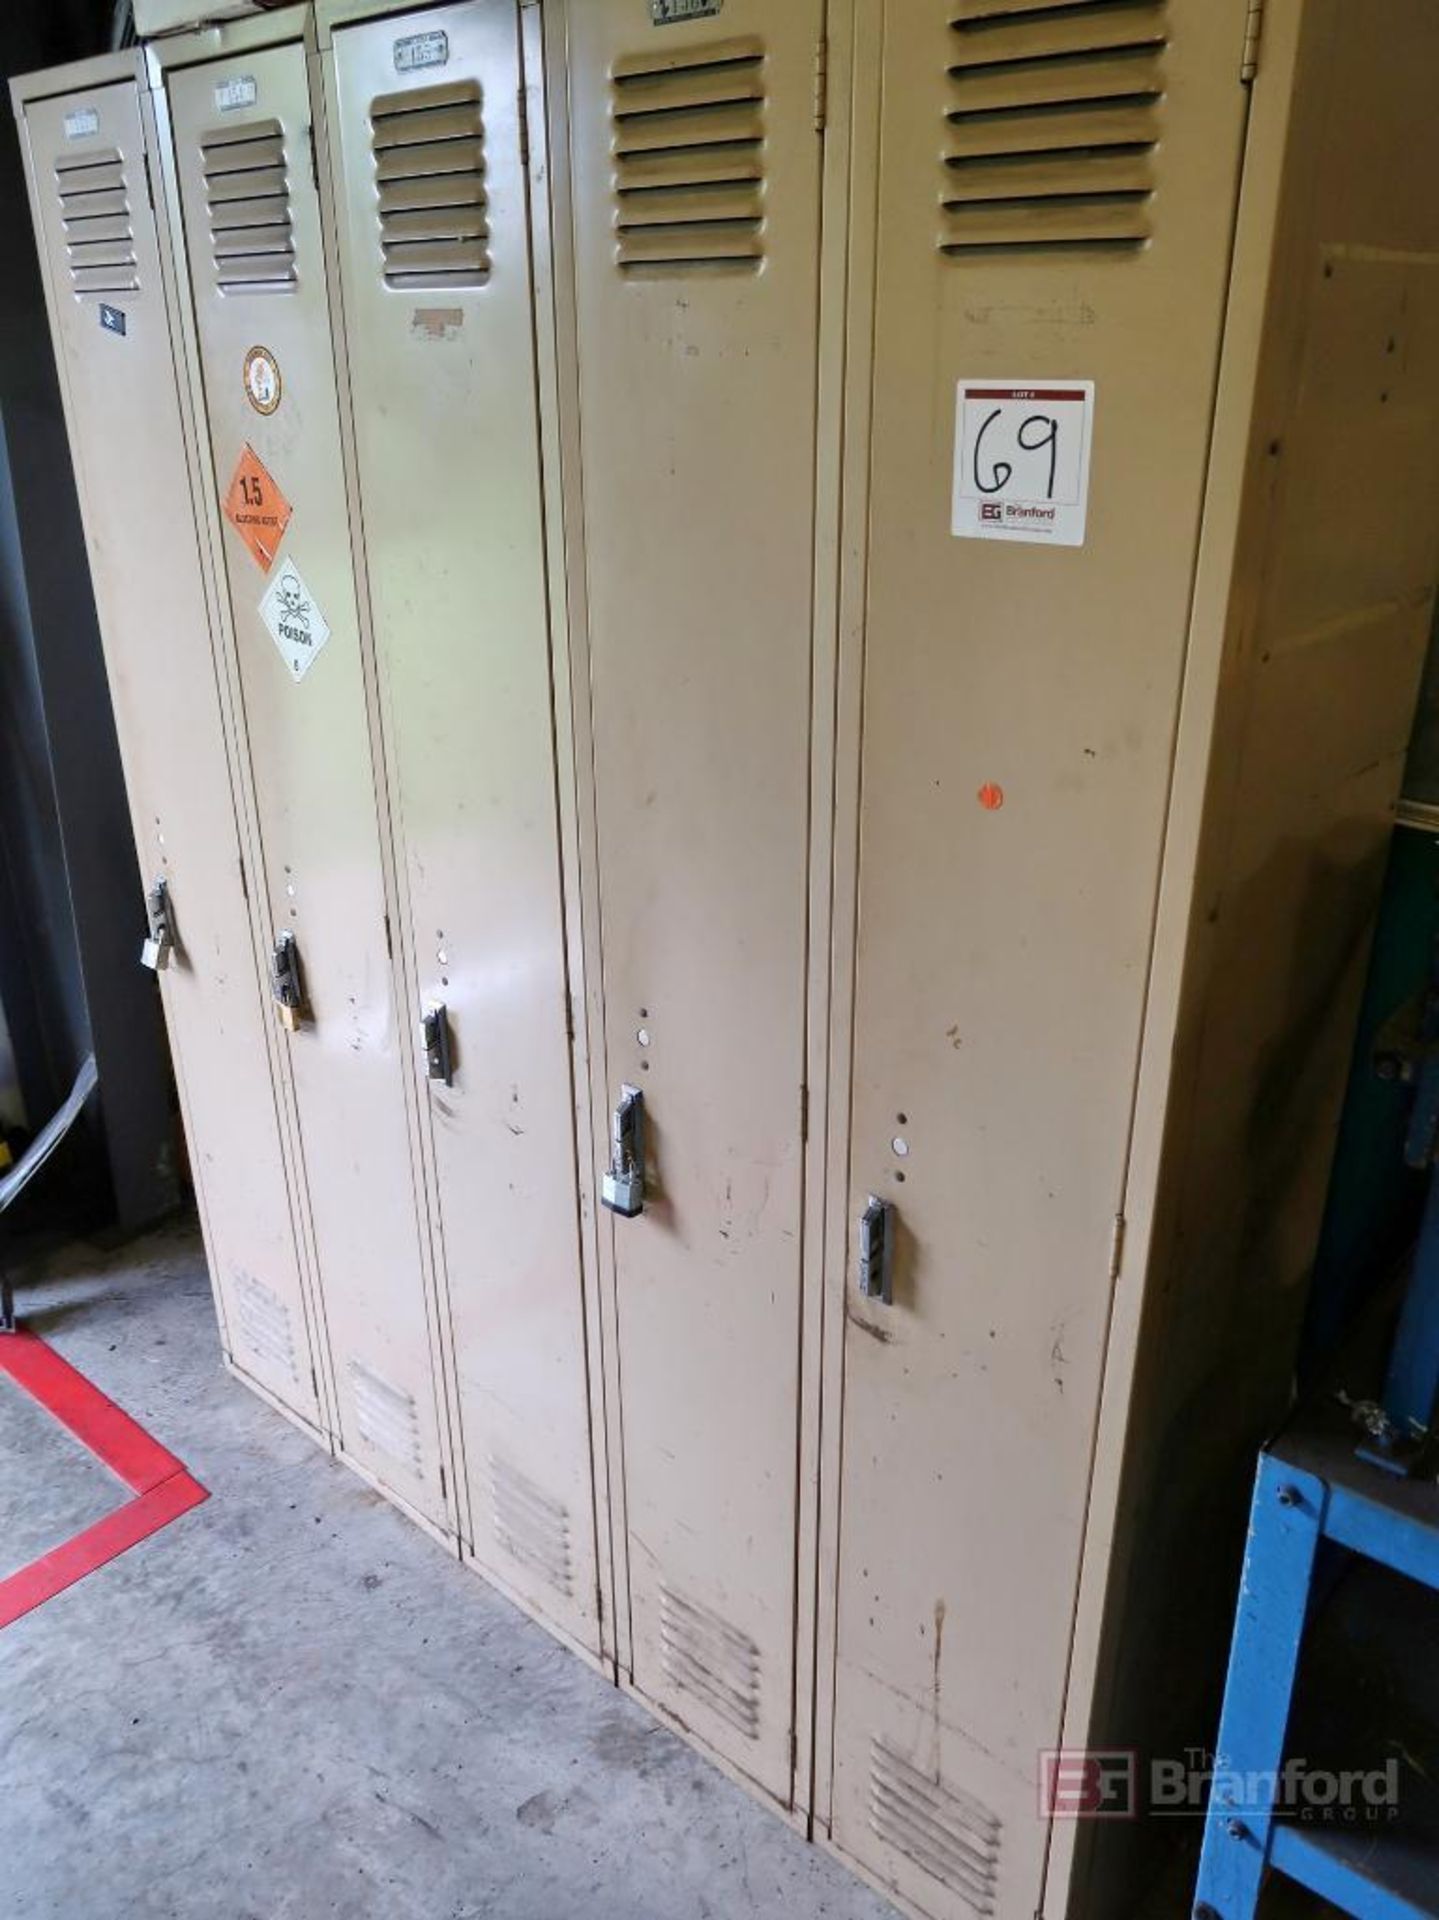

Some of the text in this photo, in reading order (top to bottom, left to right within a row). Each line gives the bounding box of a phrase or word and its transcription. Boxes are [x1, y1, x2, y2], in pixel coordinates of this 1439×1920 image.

[974, 408, 1058, 498] 69
[240, 476, 263, 506] 1.5
[1006, 505, 1056, 520] Branford
[278, 623, 312, 647] POISON
